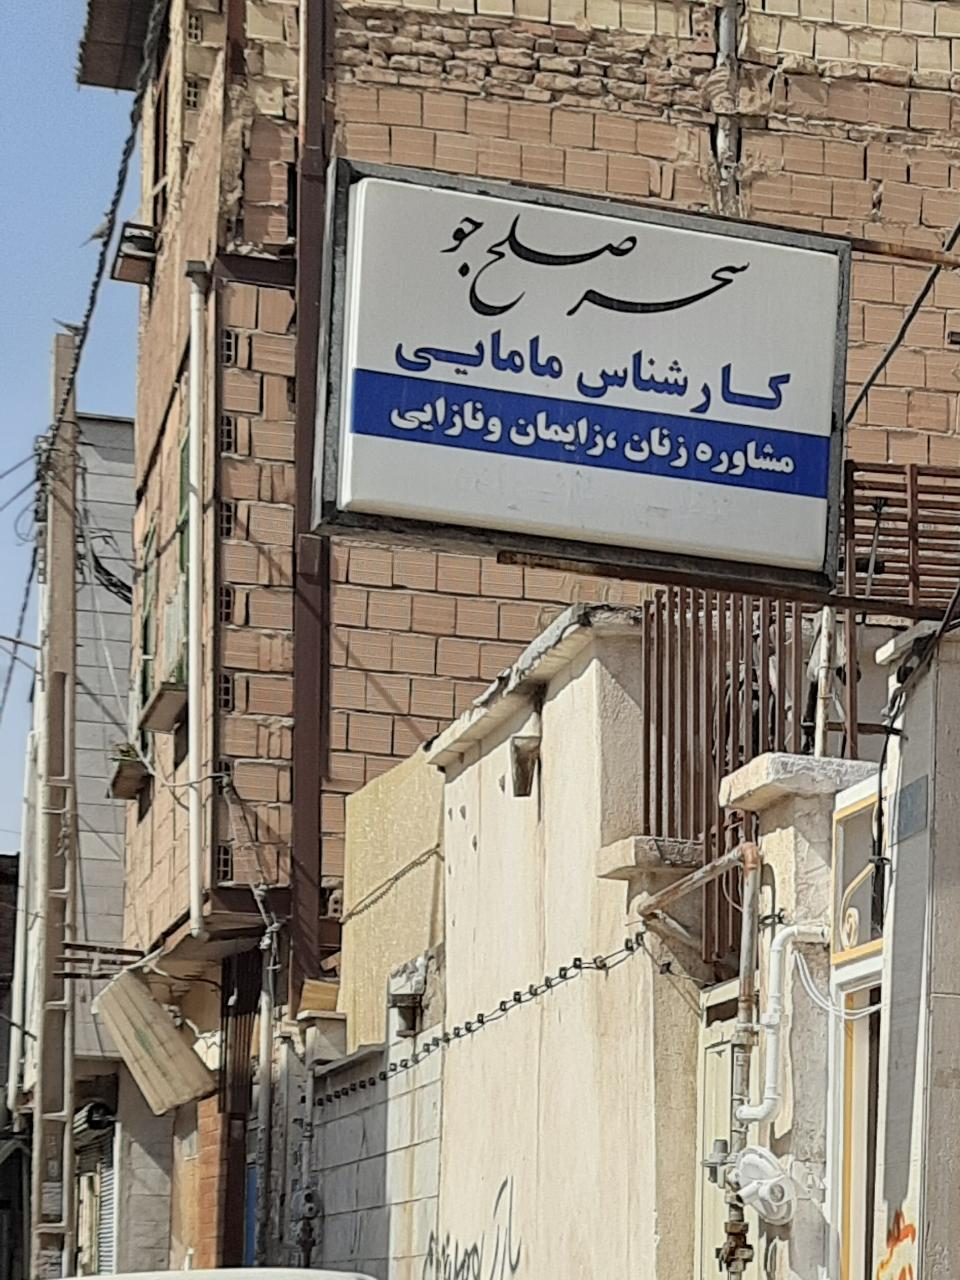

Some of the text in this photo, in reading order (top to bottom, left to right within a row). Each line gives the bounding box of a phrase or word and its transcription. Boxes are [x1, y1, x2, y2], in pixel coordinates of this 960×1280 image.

[440, 213, 751, 317] سحر صلح جو
[395, 328, 792, 415] کارشناس مامایی
[624, 424, 690, 468] زنان
[695, 439, 796, 477] مشاوره
